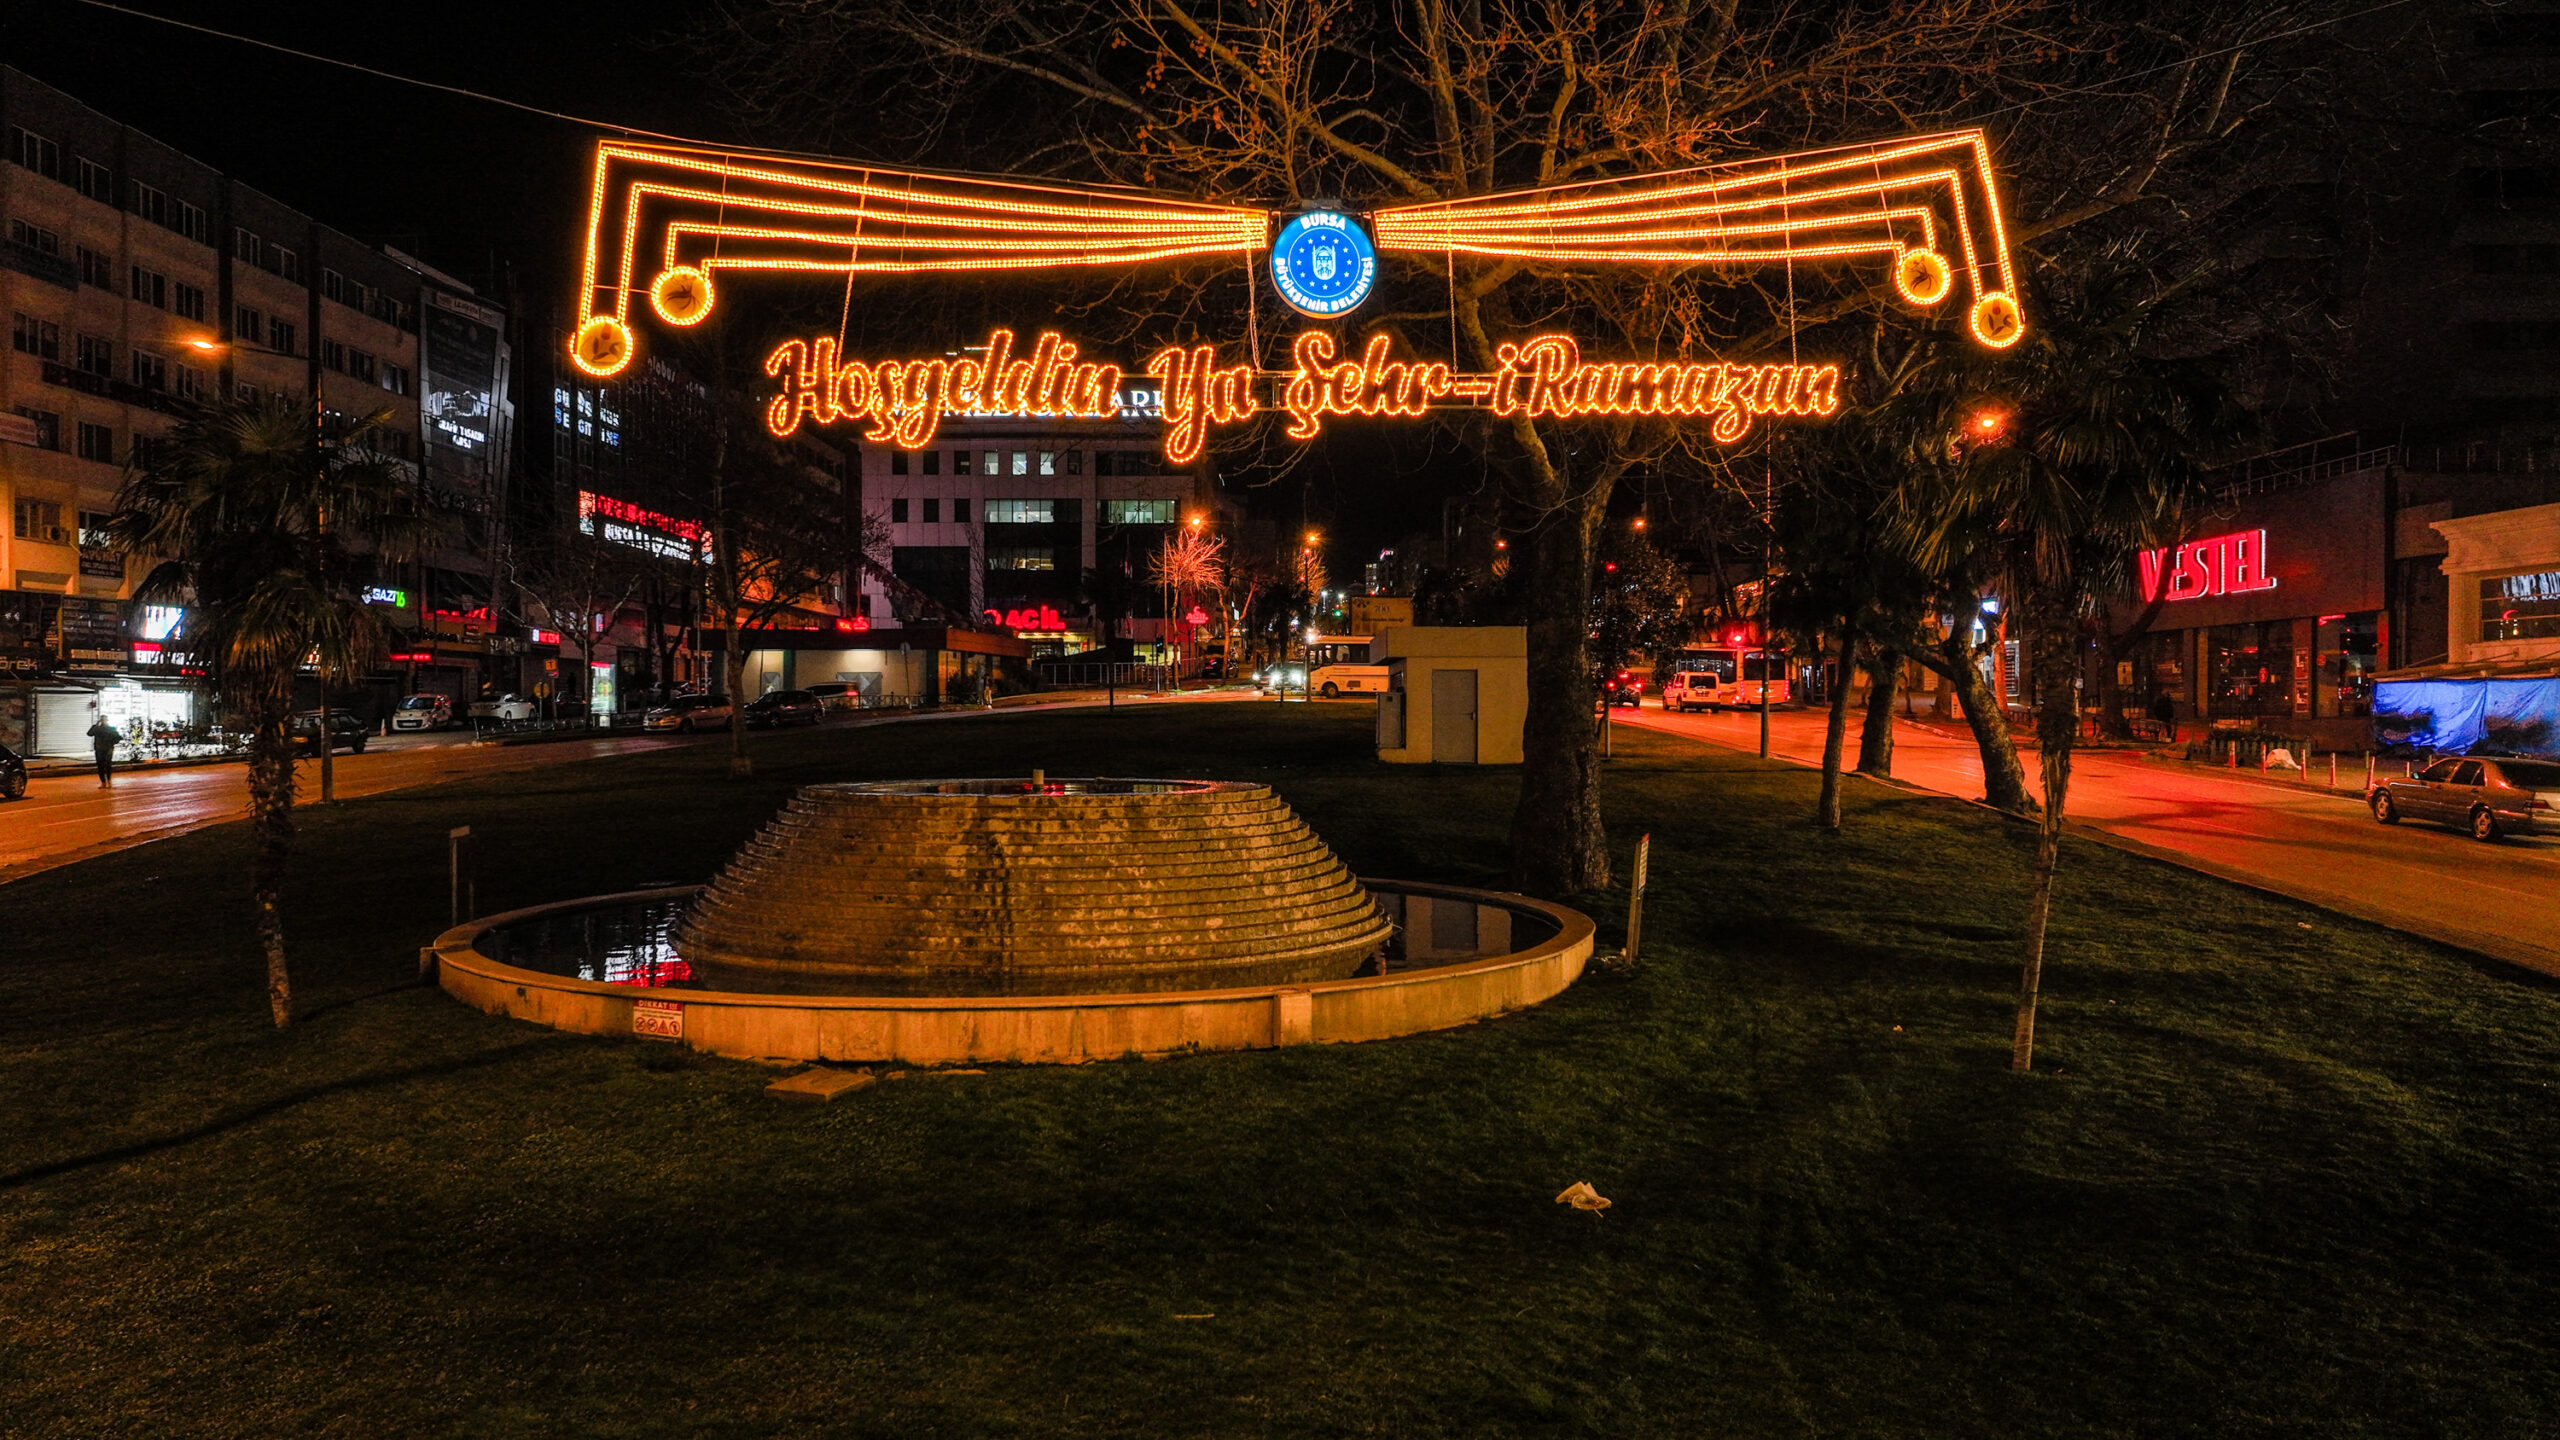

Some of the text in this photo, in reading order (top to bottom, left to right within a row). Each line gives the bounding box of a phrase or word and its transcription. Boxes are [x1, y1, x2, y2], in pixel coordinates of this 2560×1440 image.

[1300, 213, 1346, 231] BURSA
[1275, 257, 1373, 312] BÜYÜKŞEHİR BELEDİYESİ
[765, 328, 1122, 449] Hoşgeldin
[1147, 344, 1258, 464] Ya
[1519, 333, 1839, 445] Ramazan
[2138, 528, 2278, 603] VESTEL
[1004, 604, 1067, 630] ACİL
